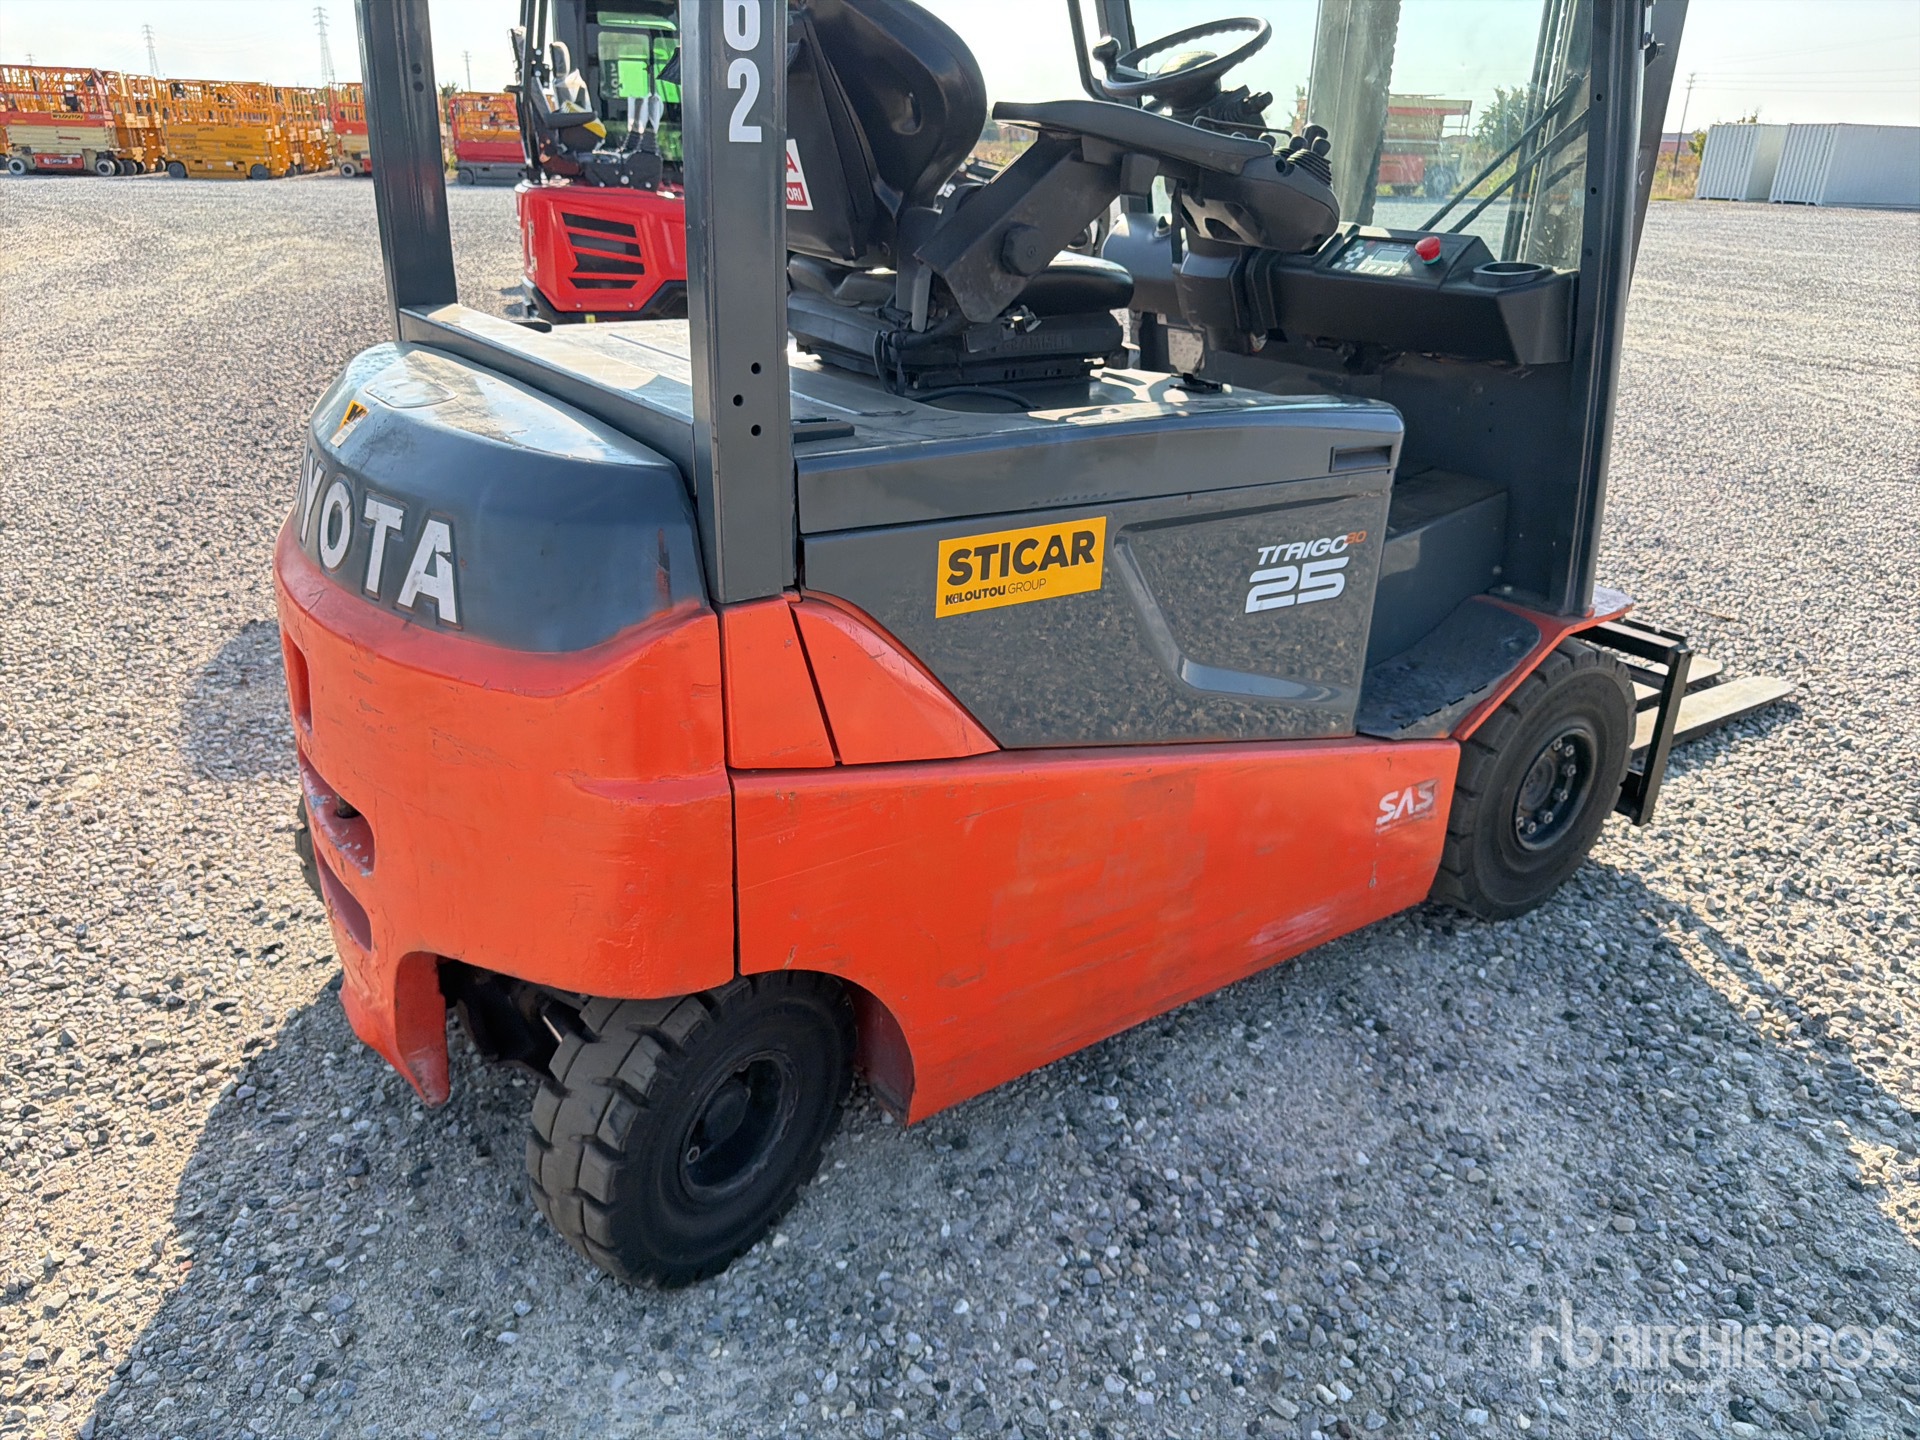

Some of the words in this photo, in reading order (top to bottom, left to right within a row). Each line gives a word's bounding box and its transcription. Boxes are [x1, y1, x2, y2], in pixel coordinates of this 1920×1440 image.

[299, 453, 457, 624] YOTA
[946, 530, 1096, 586] STICAR
[1257, 534, 1349, 566] TRAIGO
[1007, 577, 1047, 595] GROUP
[1244, 556, 1350, 614] 25
[1375, 780, 1437, 826] SAS
